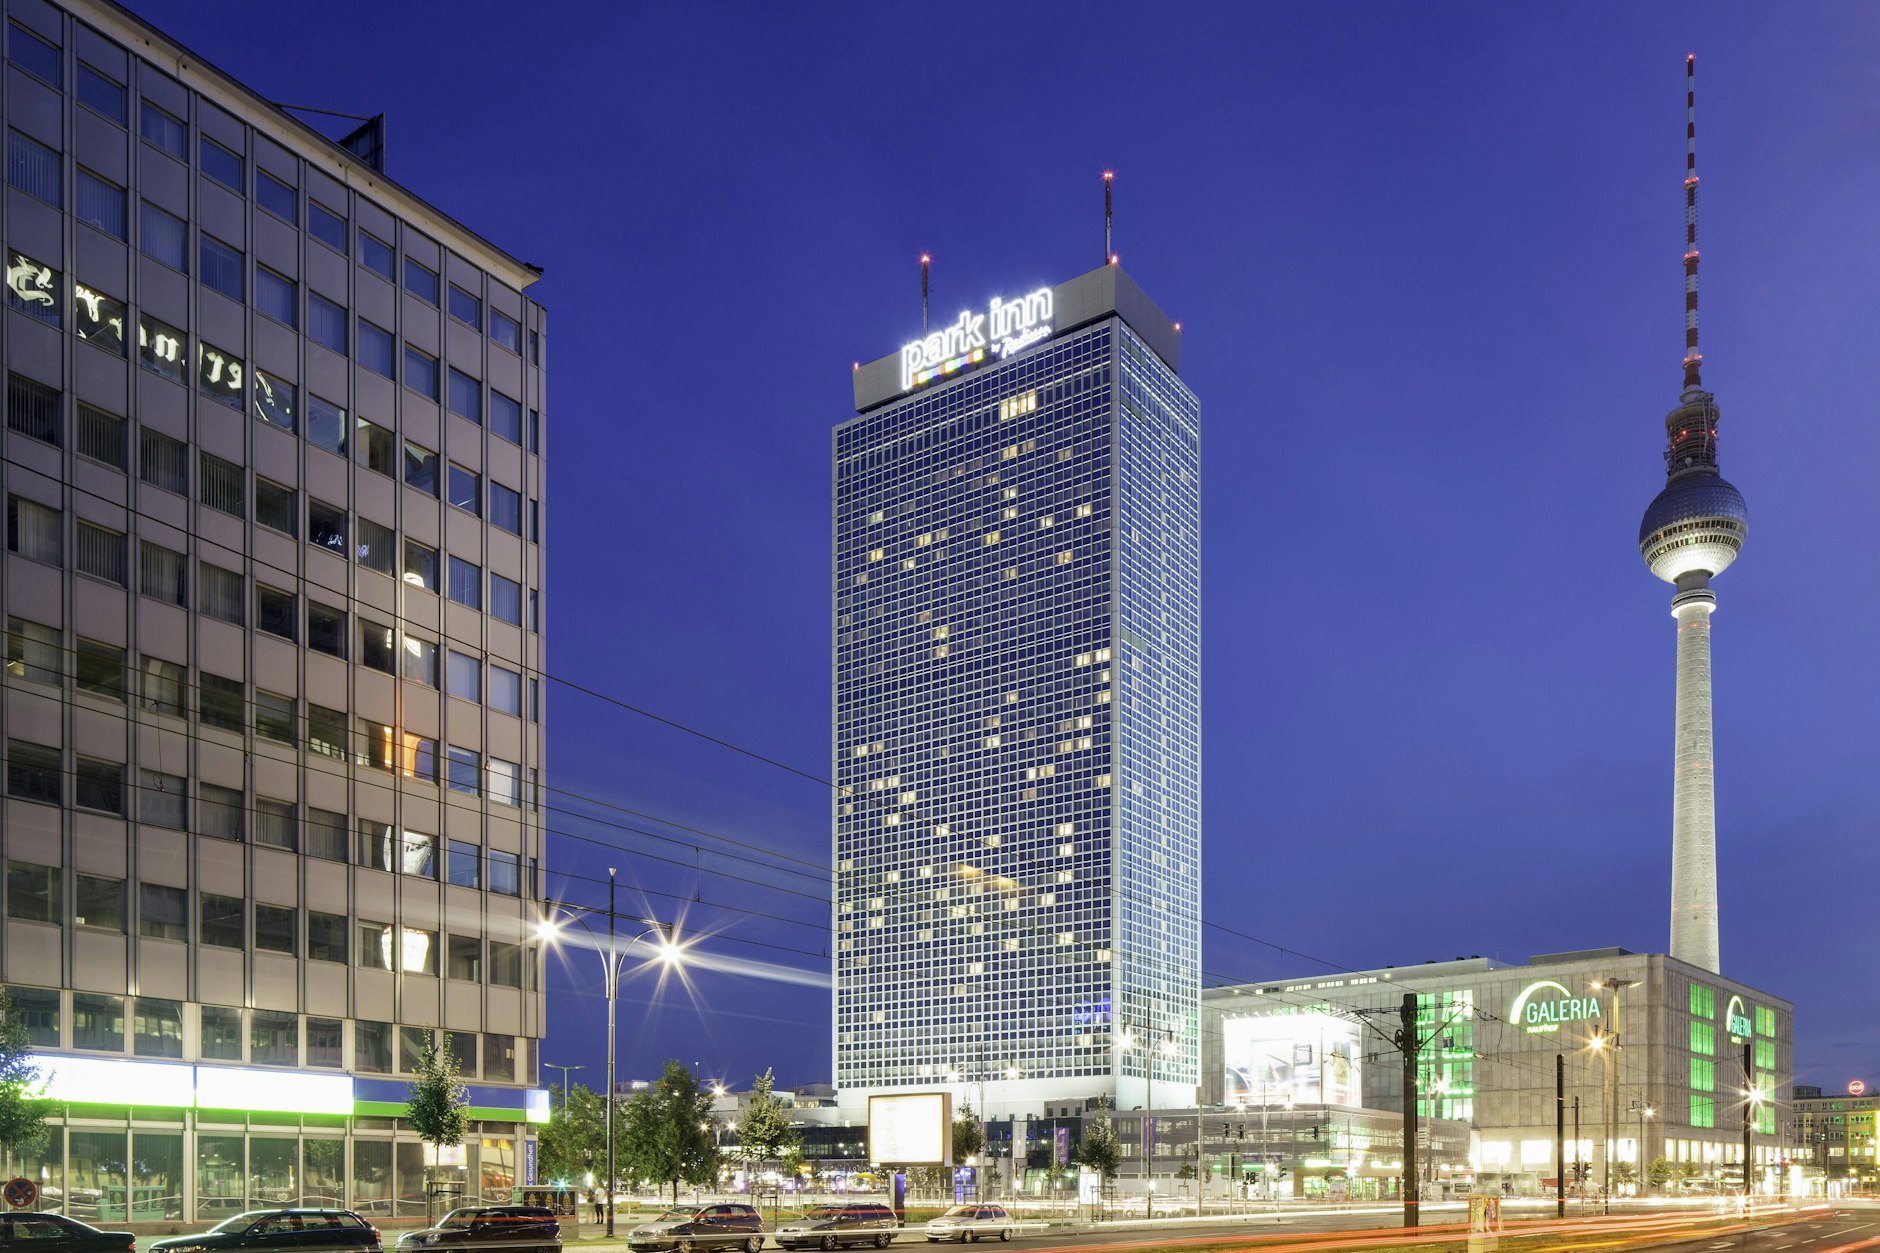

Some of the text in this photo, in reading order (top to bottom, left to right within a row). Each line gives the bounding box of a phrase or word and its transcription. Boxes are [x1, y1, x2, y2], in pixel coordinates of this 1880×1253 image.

[902, 290, 1053, 390] park inn
[1527, 998, 1600, 1023] GALERIA
[1732, 1014, 1751, 1038] GALERIA
